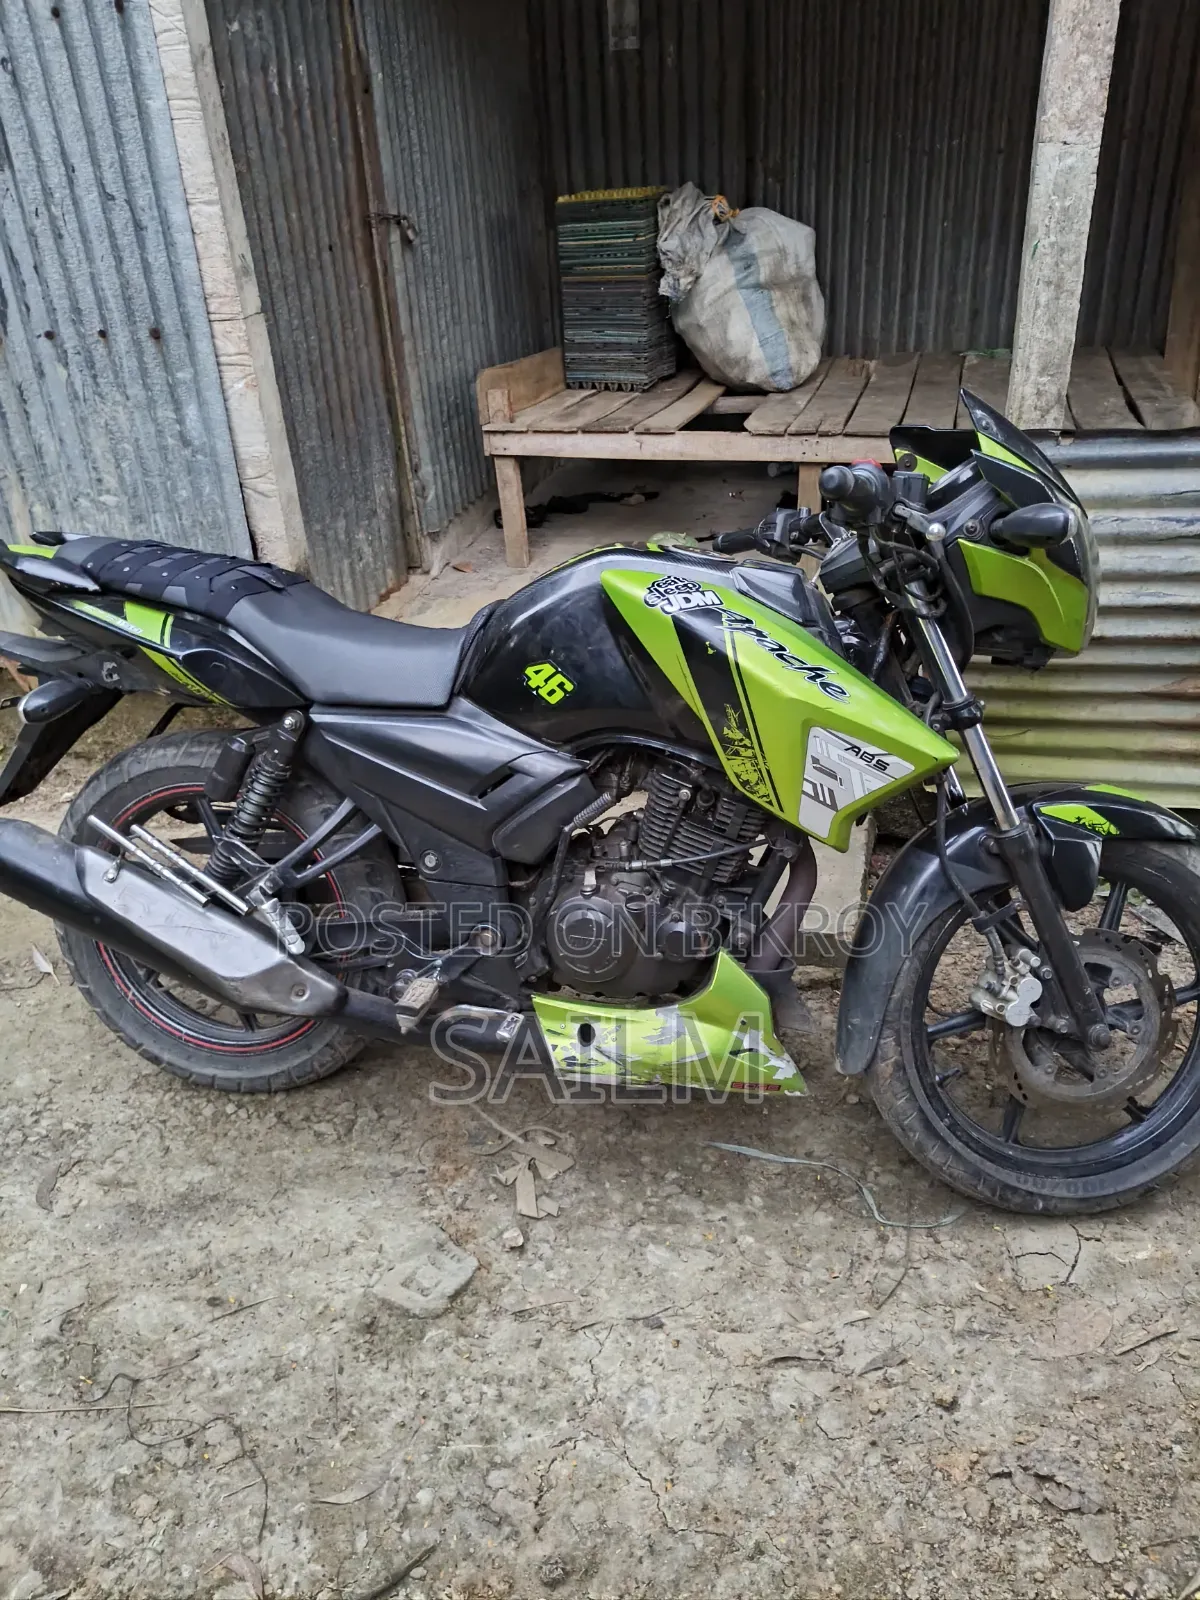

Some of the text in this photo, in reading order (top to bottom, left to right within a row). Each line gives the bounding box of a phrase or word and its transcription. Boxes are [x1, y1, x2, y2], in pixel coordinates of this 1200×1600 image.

[644, 581, 701, 607] sleep
[654, 576, 688, 590] eat
[660, 590, 724, 615] JDM
[715, 605, 850, 704] Apache
[523, 662, 575, 705] 46
[844, 745, 890, 772] ABS
